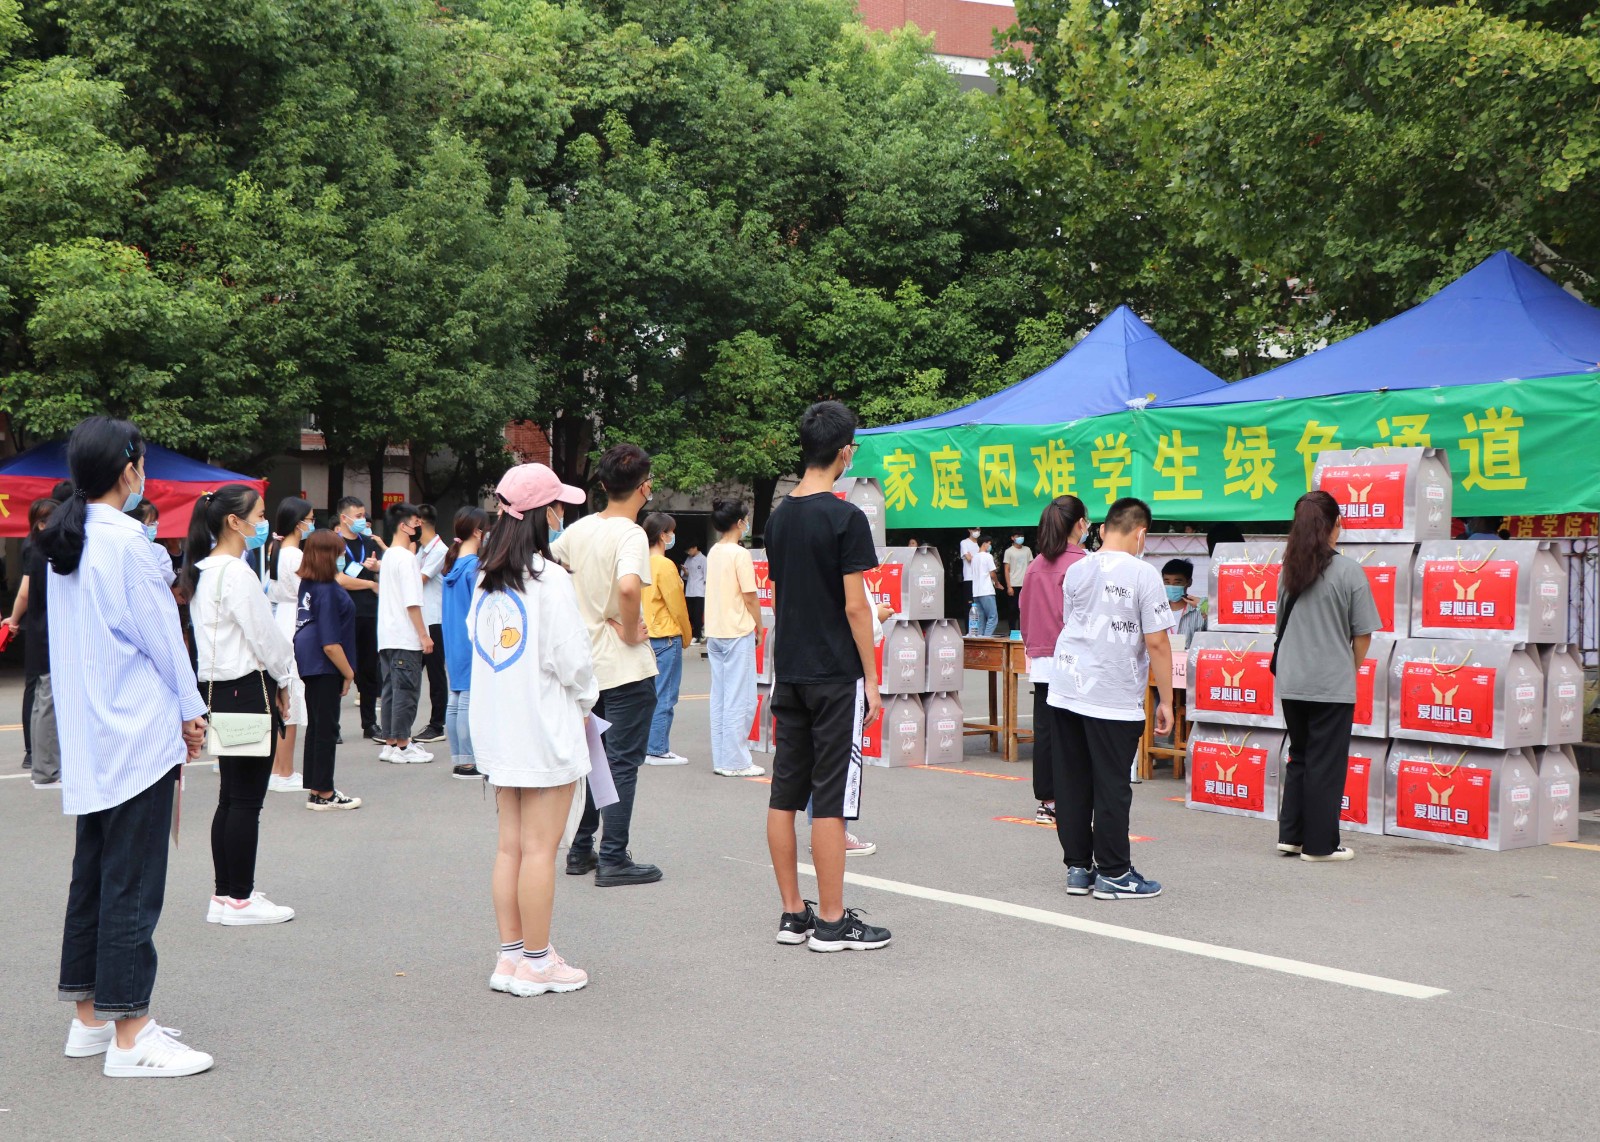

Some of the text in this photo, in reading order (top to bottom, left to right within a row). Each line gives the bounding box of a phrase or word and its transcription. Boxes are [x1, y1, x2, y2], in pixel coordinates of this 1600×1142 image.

[1104, 584, 1131, 599] MADNESS
[1232, 600, 1277, 614] 爱心礼包
[1440, 601, 1495, 617] 爱心礼包
[1110, 620, 1139, 635] MADNESS
[1172, 663, 1185, 677] 记
[1210, 686, 1257, 703] 爱心礼包
[1417, 703, 1472, 724] 爱心礼包
[1205, 780, 1248, 798] 爱心礼包
[1414, 803, 1469, 825] 爱心礼包
